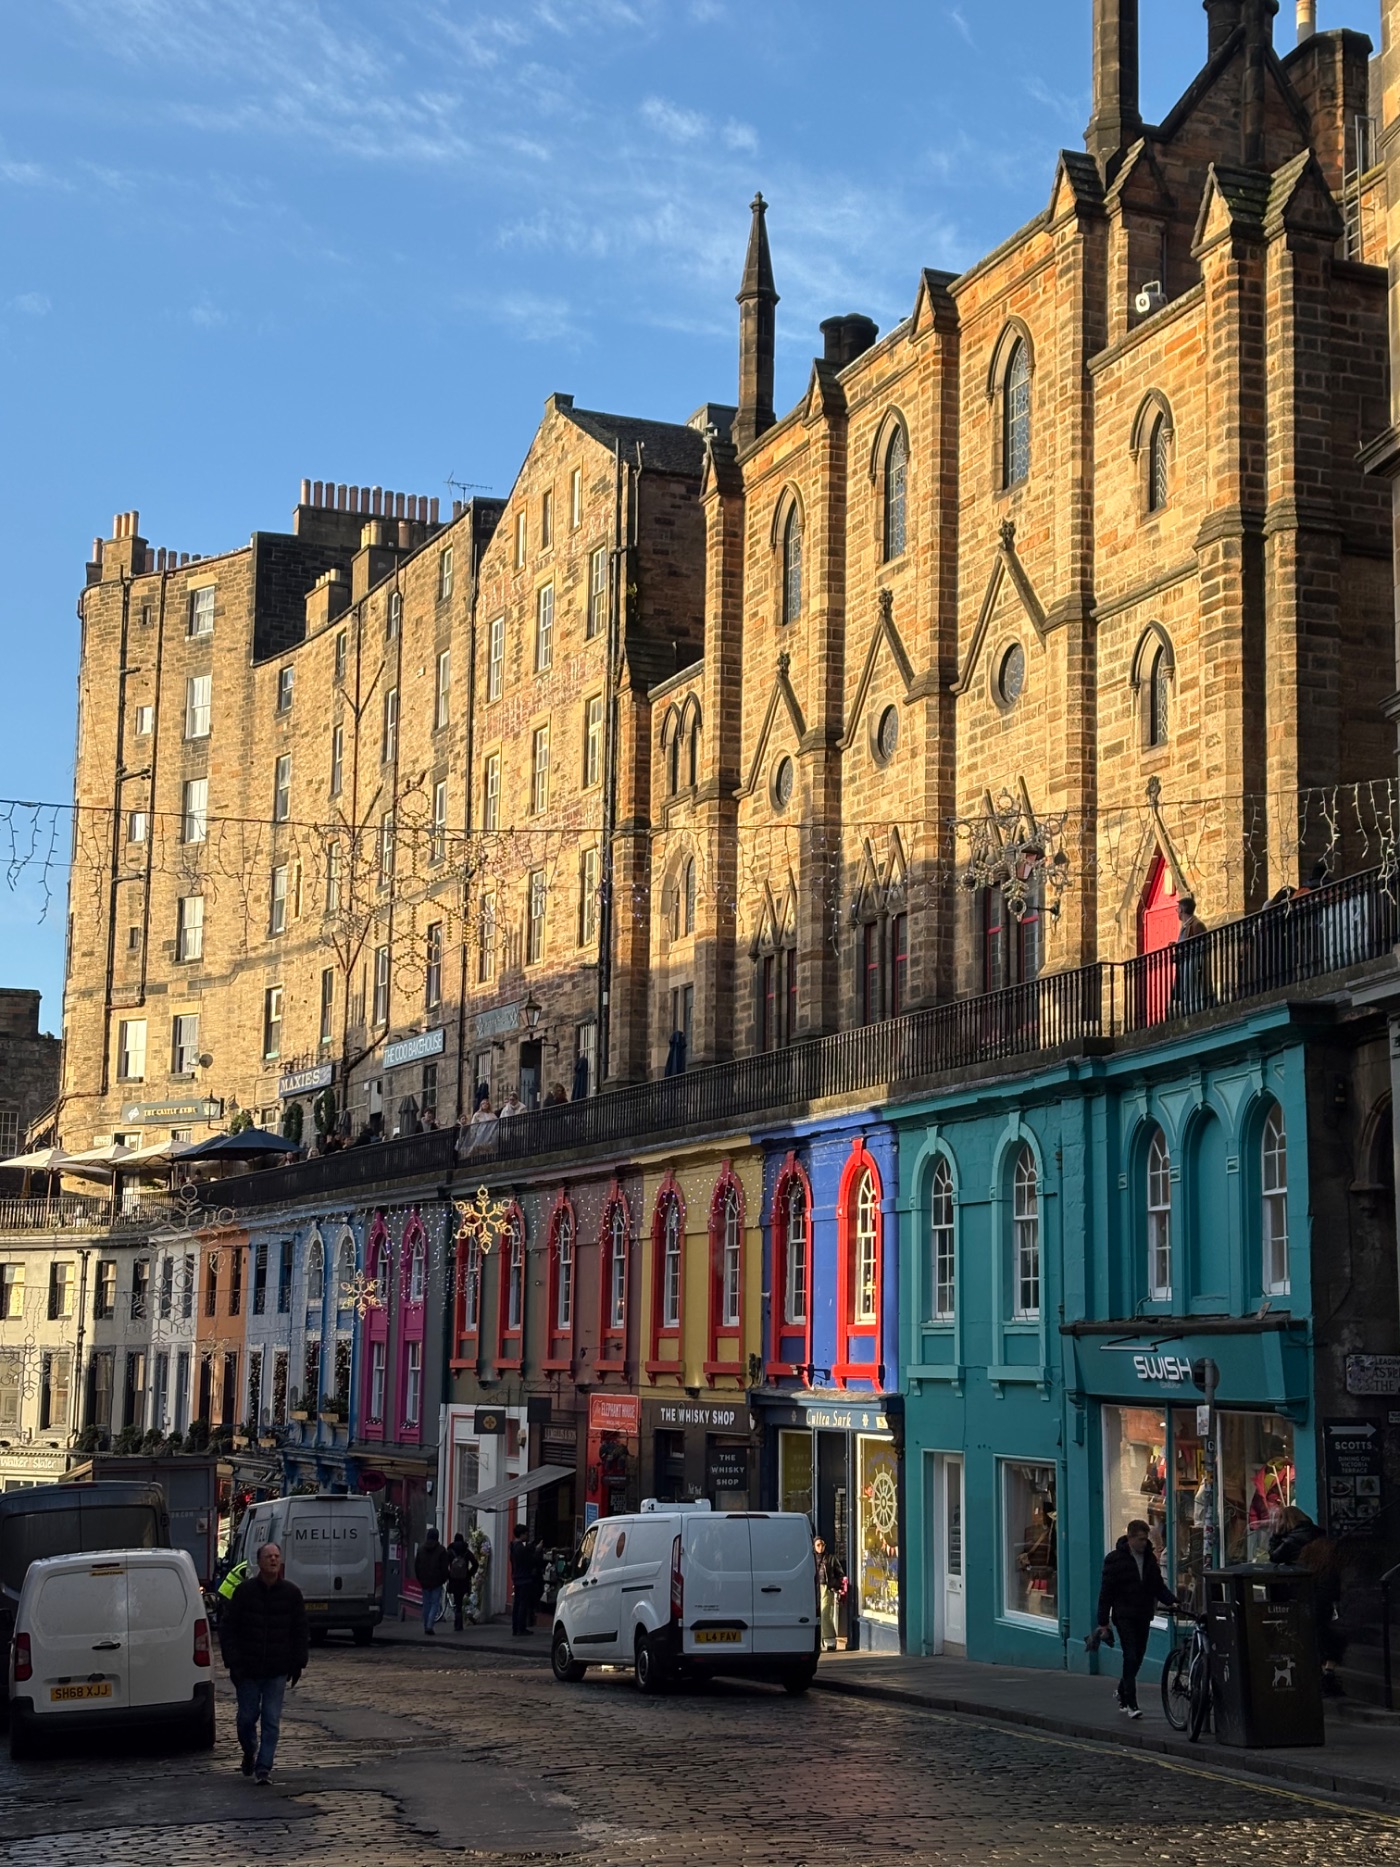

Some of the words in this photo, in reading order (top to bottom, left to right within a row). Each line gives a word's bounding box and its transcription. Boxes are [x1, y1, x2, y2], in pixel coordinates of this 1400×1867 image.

[384, 1048, 395, 1065] THE
[395, 1045, 407, 1062] COO
[408, 1033, 443, 1058] BAKEHOUSE
[144, 1109, 155, 1117] THE
[156, 1107, 178, 1116] CASTLE
[1133, 1356, 1193, 1380] SWISH
[1374, 1380, 1395, 1391] THE
[601, 1402, 621, 1418] ELEPHANT
[622, 1403, 636, 1419] HOUSE
[660, 1407, 676, 1422] THE
[678, 1408, 710, 1424] WHISKY
[712, 1410, 735, 1425] SHOP
[833, 1410, 852, 1427] Sark
[1335, 1441, 1372, 1450] SCOTTS
[33, 1457, 56, 1469] Slater
[711, 1466, 745, 1474] WHISKY
[295, 1528, 358, 1540] MELLIS
[1268, 1605, 1289, 1613] Litter
[706, 1631, 717, 1642] L4
[720, 1631, 737, 1641] FAV
[55, 1687, 84, 1699] SH68
[86, 1686, 108, 1697] XJJ
